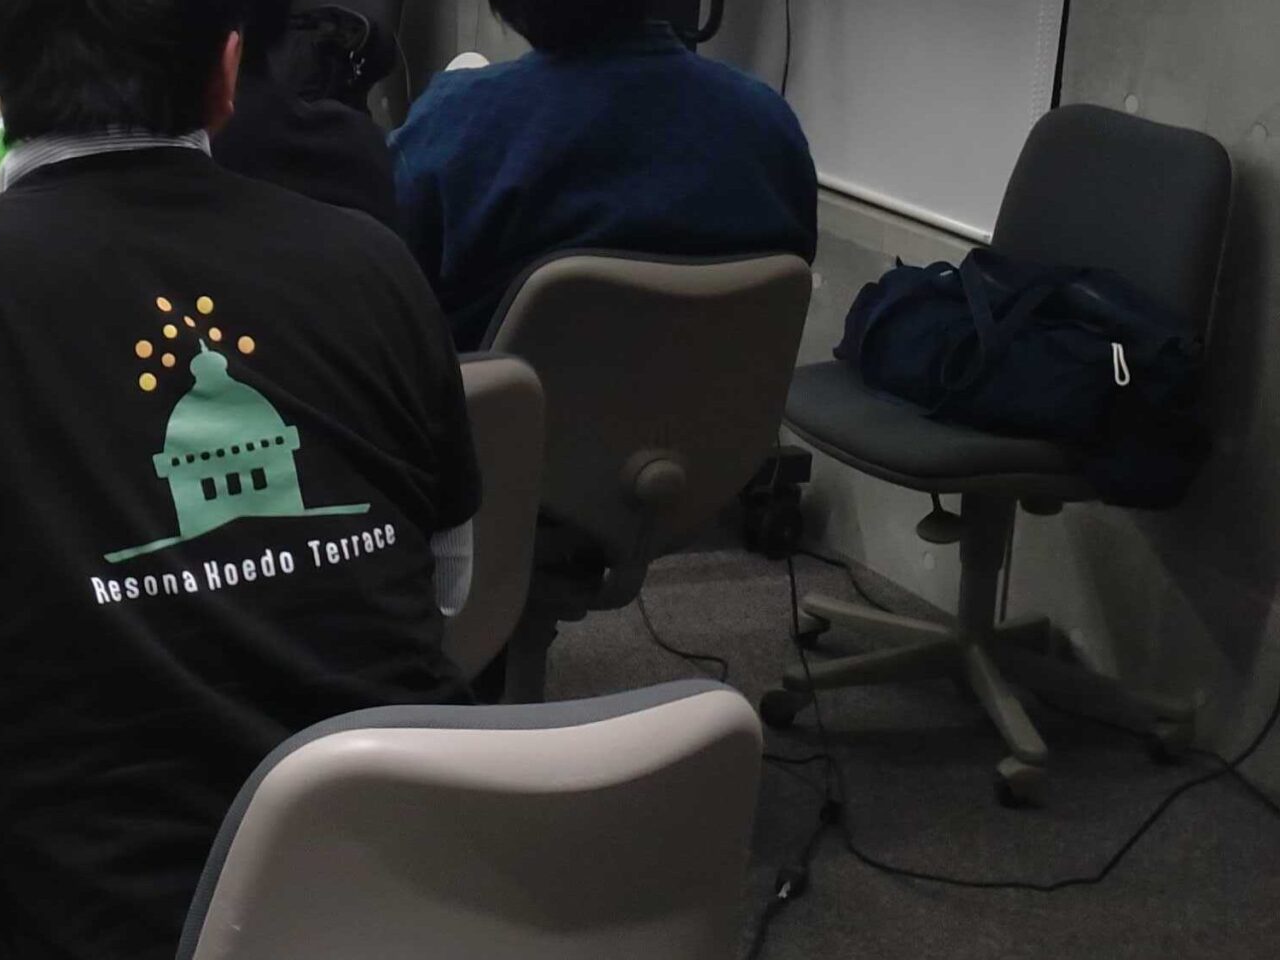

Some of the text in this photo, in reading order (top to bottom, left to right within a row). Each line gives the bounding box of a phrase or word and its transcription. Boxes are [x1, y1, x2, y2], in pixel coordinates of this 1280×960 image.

[91, 523, 396, 605] Resona Koedo Terrace
